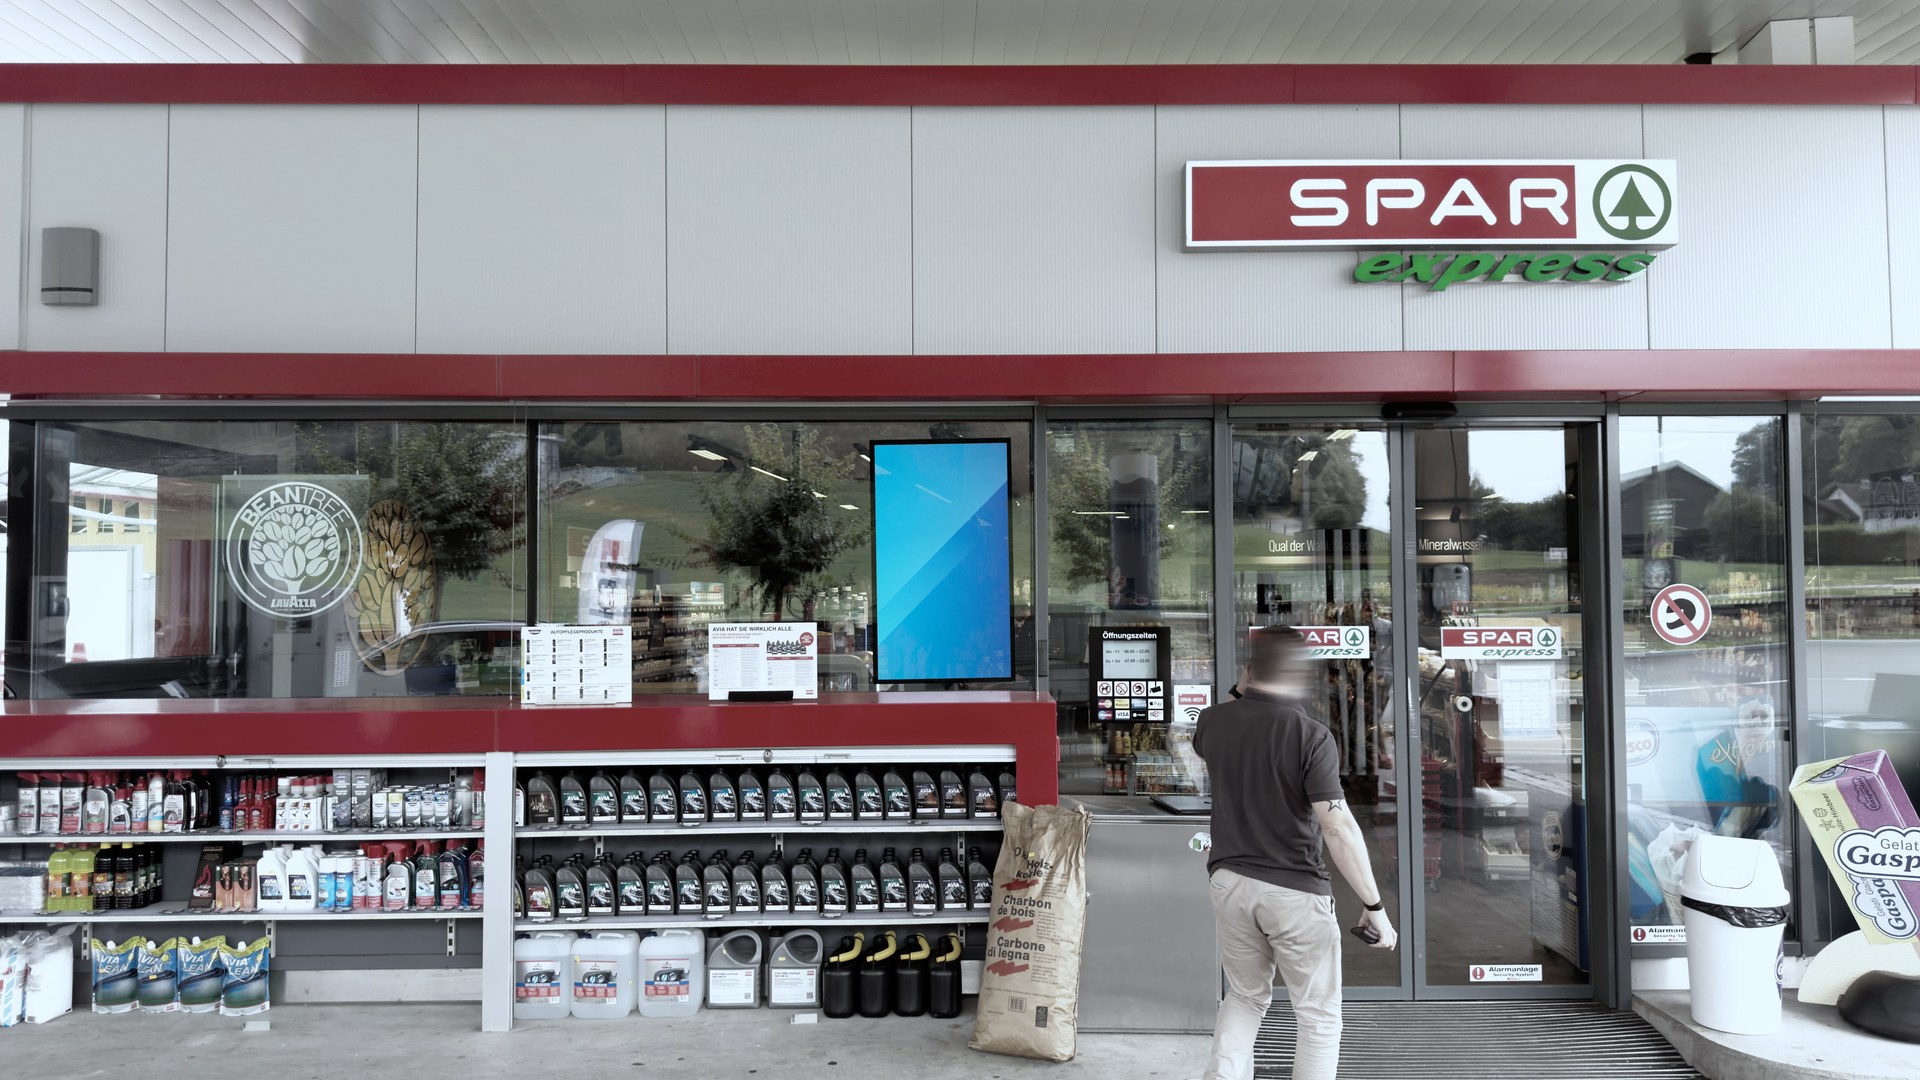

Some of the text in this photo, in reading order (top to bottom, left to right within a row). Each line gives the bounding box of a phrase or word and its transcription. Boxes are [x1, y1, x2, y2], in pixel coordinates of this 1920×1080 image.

[1290, 178, 1570, 226] SPAR
[1353, 250, 1658, 291] express
[240, 486, 350, 528] BEANTREE
[1268, 540, 1288, 552] Qual
[1290, 539, 1305, 552] der
[270, 596, 316, 608] LAVAZZA
[1102, 631, 1157, 640] Öffnungszeiten
[1463, 631, 1532, 644] SPAR
[1311, 648, 1364, 657] press
[1482, 648, 1556, 658] express
[1004, 895, 1052, 909] Charbon
[998, 905, 1035, 917] de bois
[997, 936, 1046, 952] Carbone
[988, 947, 1030, 961] di legna
